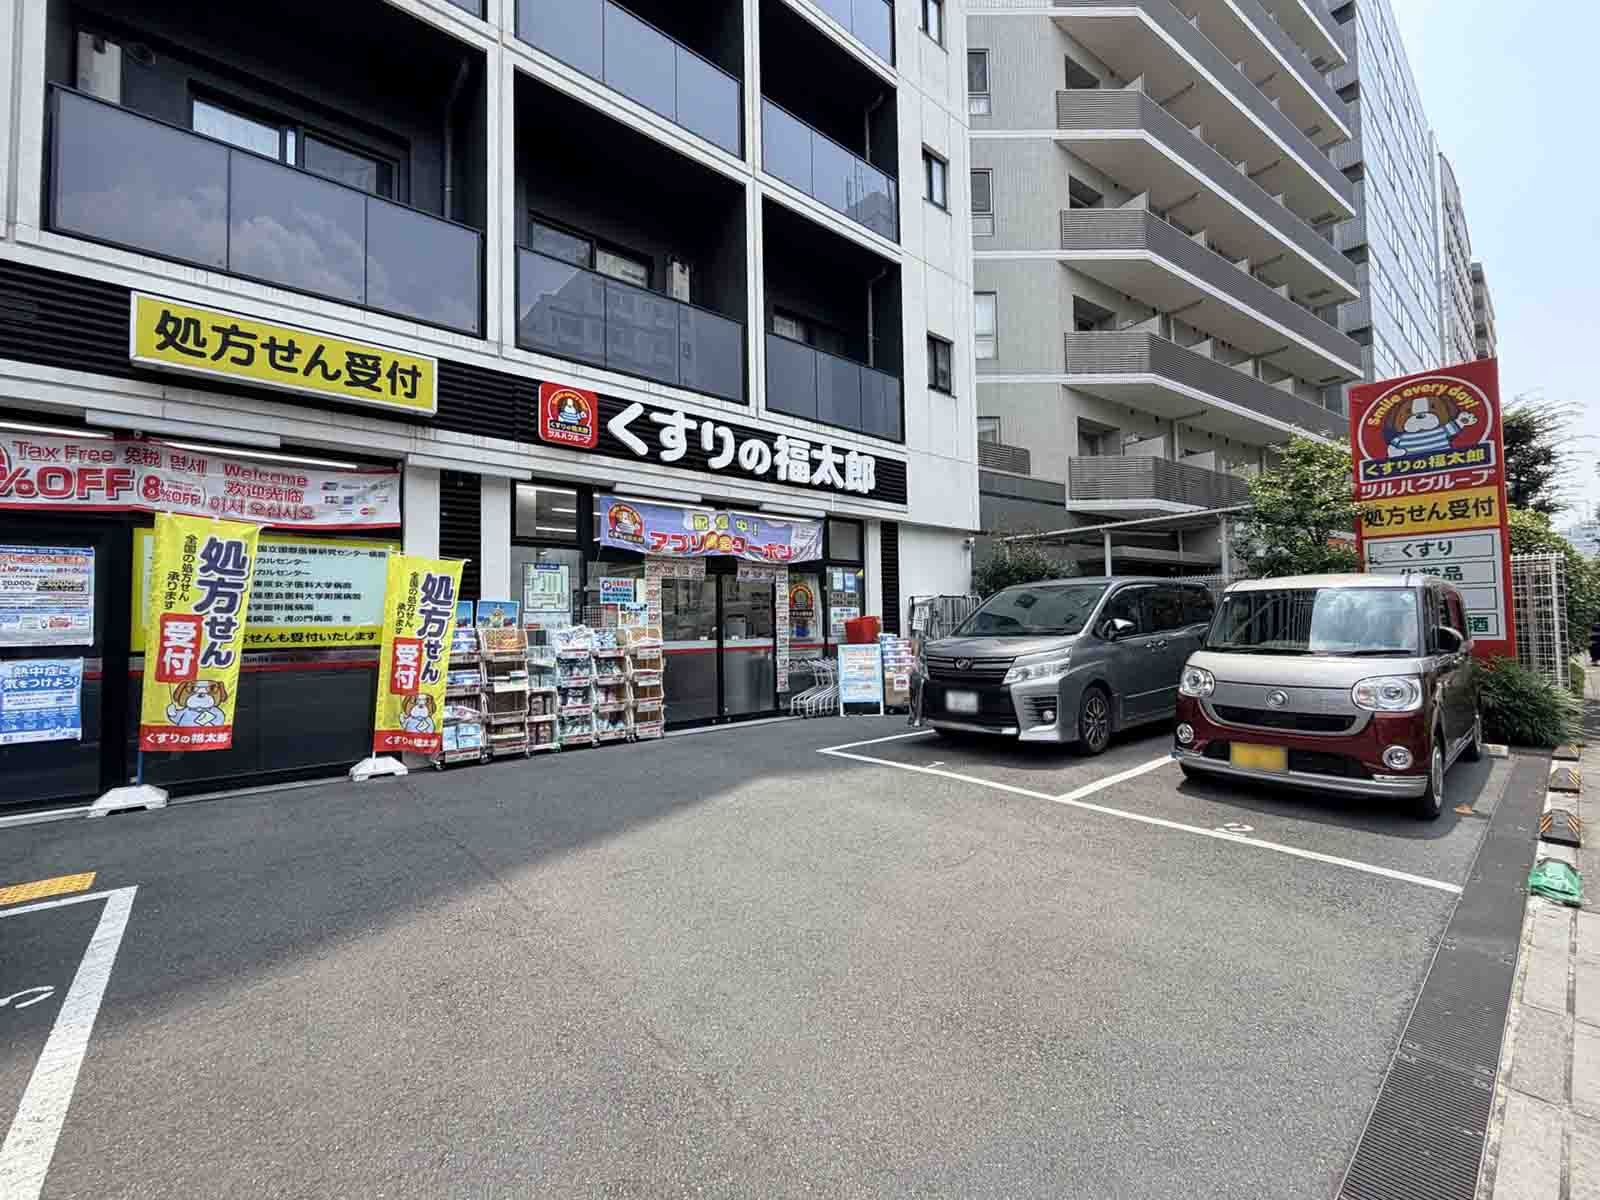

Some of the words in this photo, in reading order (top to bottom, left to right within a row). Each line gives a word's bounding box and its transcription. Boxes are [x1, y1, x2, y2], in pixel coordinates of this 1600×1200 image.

[154, 309, 422, 399] 処方せん受付
[1367, 395, 1401, 427] Smile
[1402, 383, 1449, 398] every
[14, 440, 58, 460] Tax
[64, 445, 113, 464] Free
[607, 402, 876, 494] くすりの福太郎
[1365, 448, 1486, 476] くすりの福太郎
[224, 464, 308, 488] Welcome
[1360, 468, 1496, 498] ツルハグループ
[1362, 496, 1495, 528] 処方せん受付
[178, 534, 197, 602] 全国の処方せん
[1401, 540, 1453, 558] くすり
[194, 537, 248, 668] 処方せん
[162, 620, 197, 676] 受付
[417, 573, 454, 683] 処方せん
[395, 645, 417, 689] 受付
[146, 733, 229, 744] くすりの福太郎
